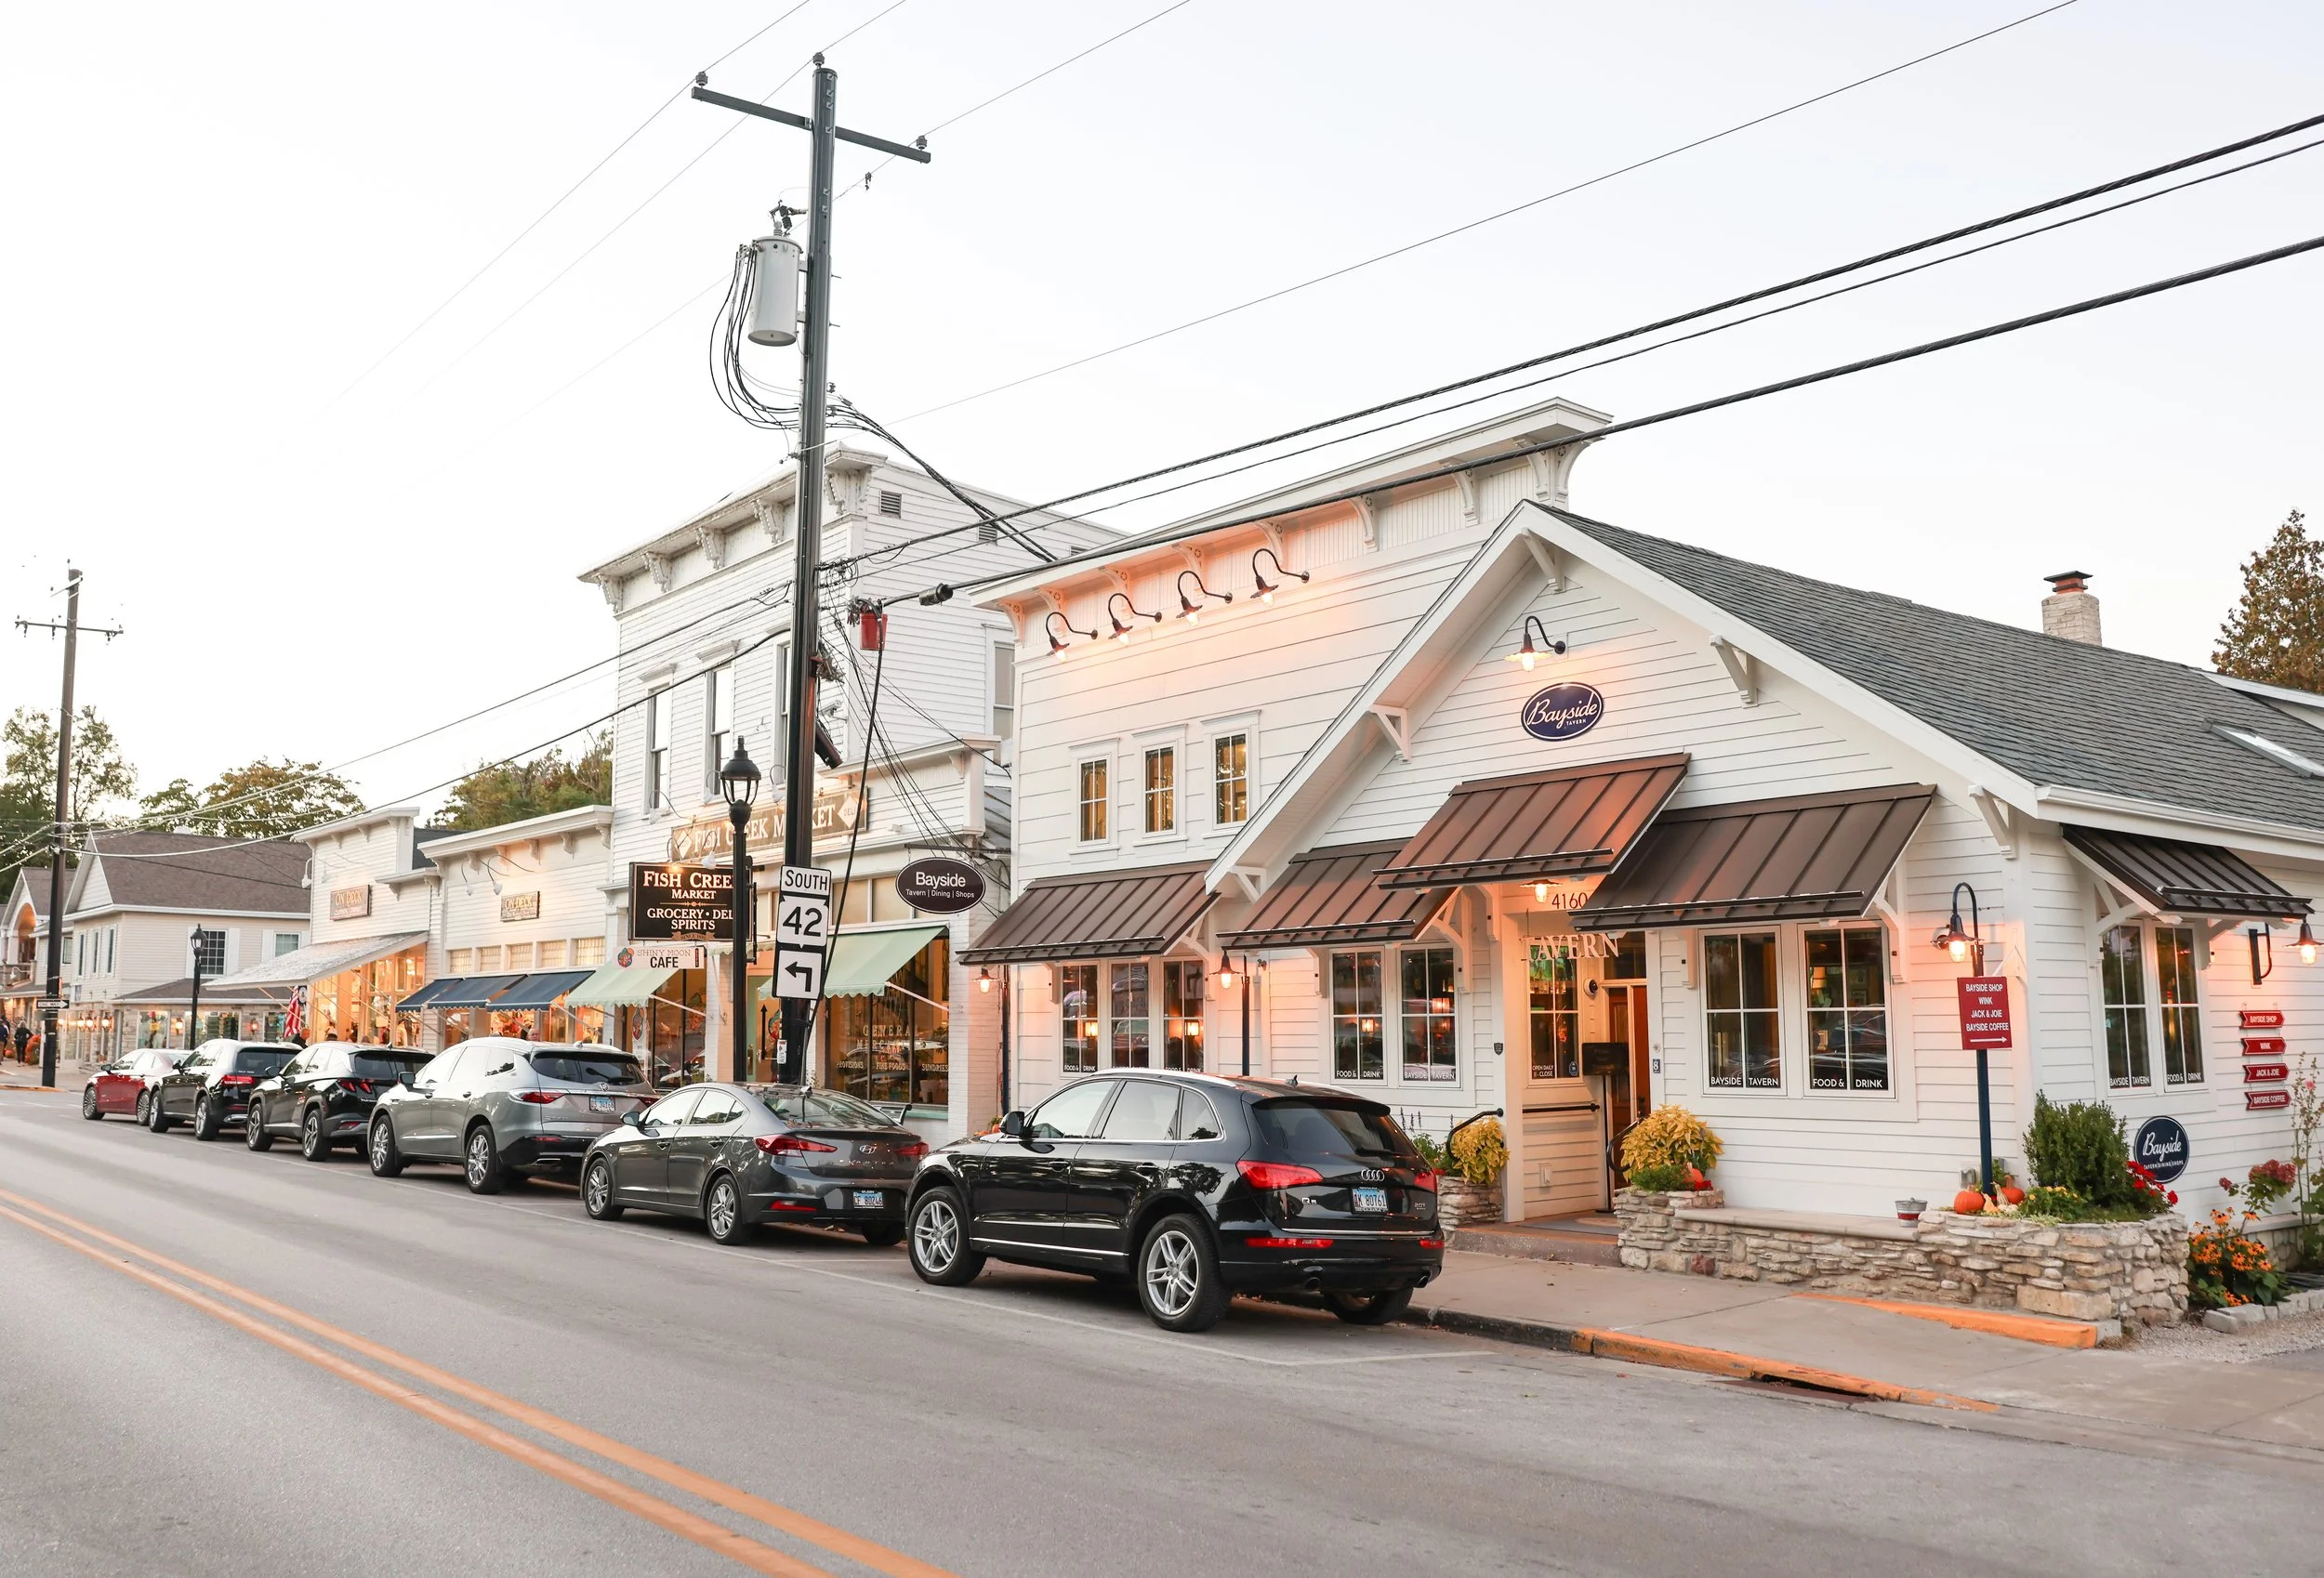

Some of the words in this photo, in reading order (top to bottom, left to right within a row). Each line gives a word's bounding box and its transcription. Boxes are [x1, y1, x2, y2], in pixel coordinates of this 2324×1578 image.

[1526, 690, 1598, 730] Bayside
[694, 827, 720, 852] FISH
[726, 817, 769, 846] CEEK
[773, 804, 836, 838] MKET
[643, 871, 682, 888] FISH
[690, 872, 733, 889] CREE
[785, 870, 827, 891] SOUTH
[916, 871, 966, 889] Bayside
[336, 893, 345, 906] ON
[671, 889, 717, 900] MARKET
[931, 889, 951, 898] Dining
[956, 890, 975, 899] Shops
[1552, 892, 1588, 909] 4160
[647, 908, 705, 920] GROCERY
[713, 910, 733, 920] DEL
[671, 920, 716, 930] SPIRITS
[783, 906, 822, 937] 42
[1524, 932, 1619, 962] TAVERN
[650, 956, 679, 968] CAFE
[1965, 983, 1987, 992] BAYSIDE
[1988, 983, 2003, 992] SHOP
[1978, 996, 1993, 1005] WINK
[1971, 1009, 1986, 1019] JACK
[1990, 1009, 2002, 1018] JOIE
[1966, 1023, 1988, 1032] BAYSIDE
[1988, 1022, 2009, 1031] COFFEE
[2259, 1042, 2271, 1050] WINK
[837, 1060, 865, 1069] PROVISIONS
[1432, 1072, 1455, 1080] TAVERN
[2167, 1073, 2179, 1083] FOOD
[2179, 1073, 2184, 1082] &
[2187, 1072, 2201, 1081] DRINK
[2256, 1069, 2267, 1077] JACK
[1710, 1077, 1741, 1085] BAYSIDE
[1749, 1077, 1778, 1086] TAVERN
[1813, 1078, 1837, 1087] FOOD
[1838, 1079, 1844, 1087] &
[1855, 1079, 1882, 1088] DRINK
[2109, 1077, 2129, 1086] BAYSIDE
[2132, 1076, 2150, 1085] TAVERN
[2253, 1096, 2270, 1104] BAYSIDE
[2270, 1095, 2286, 1103] COFFEE
[2143, 1130, 2182, 1162] Bayside
[1366, 1194, 1387, 1207] 80761
